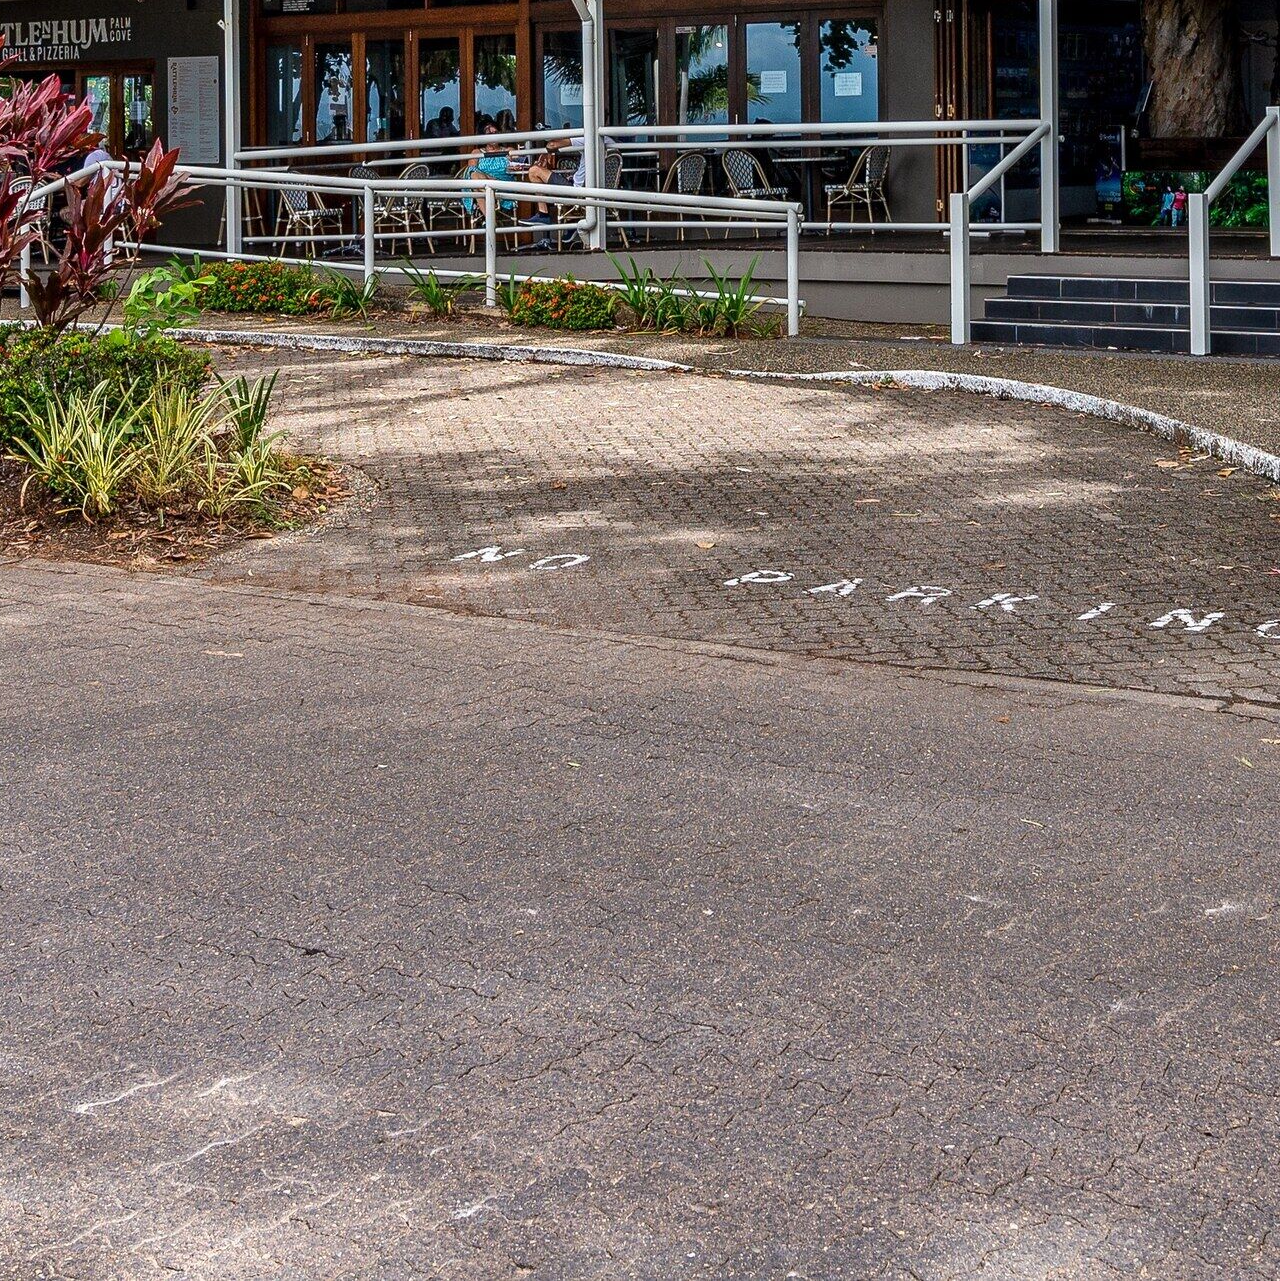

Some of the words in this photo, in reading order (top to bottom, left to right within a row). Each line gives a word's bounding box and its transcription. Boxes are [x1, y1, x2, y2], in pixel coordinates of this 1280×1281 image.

[110, 17, 131, 28] PALM
[109, 30, 131, 42] COVE
[37, 44, 80, 61] PIZZERIA
[450, 545, 591, 570] NO
